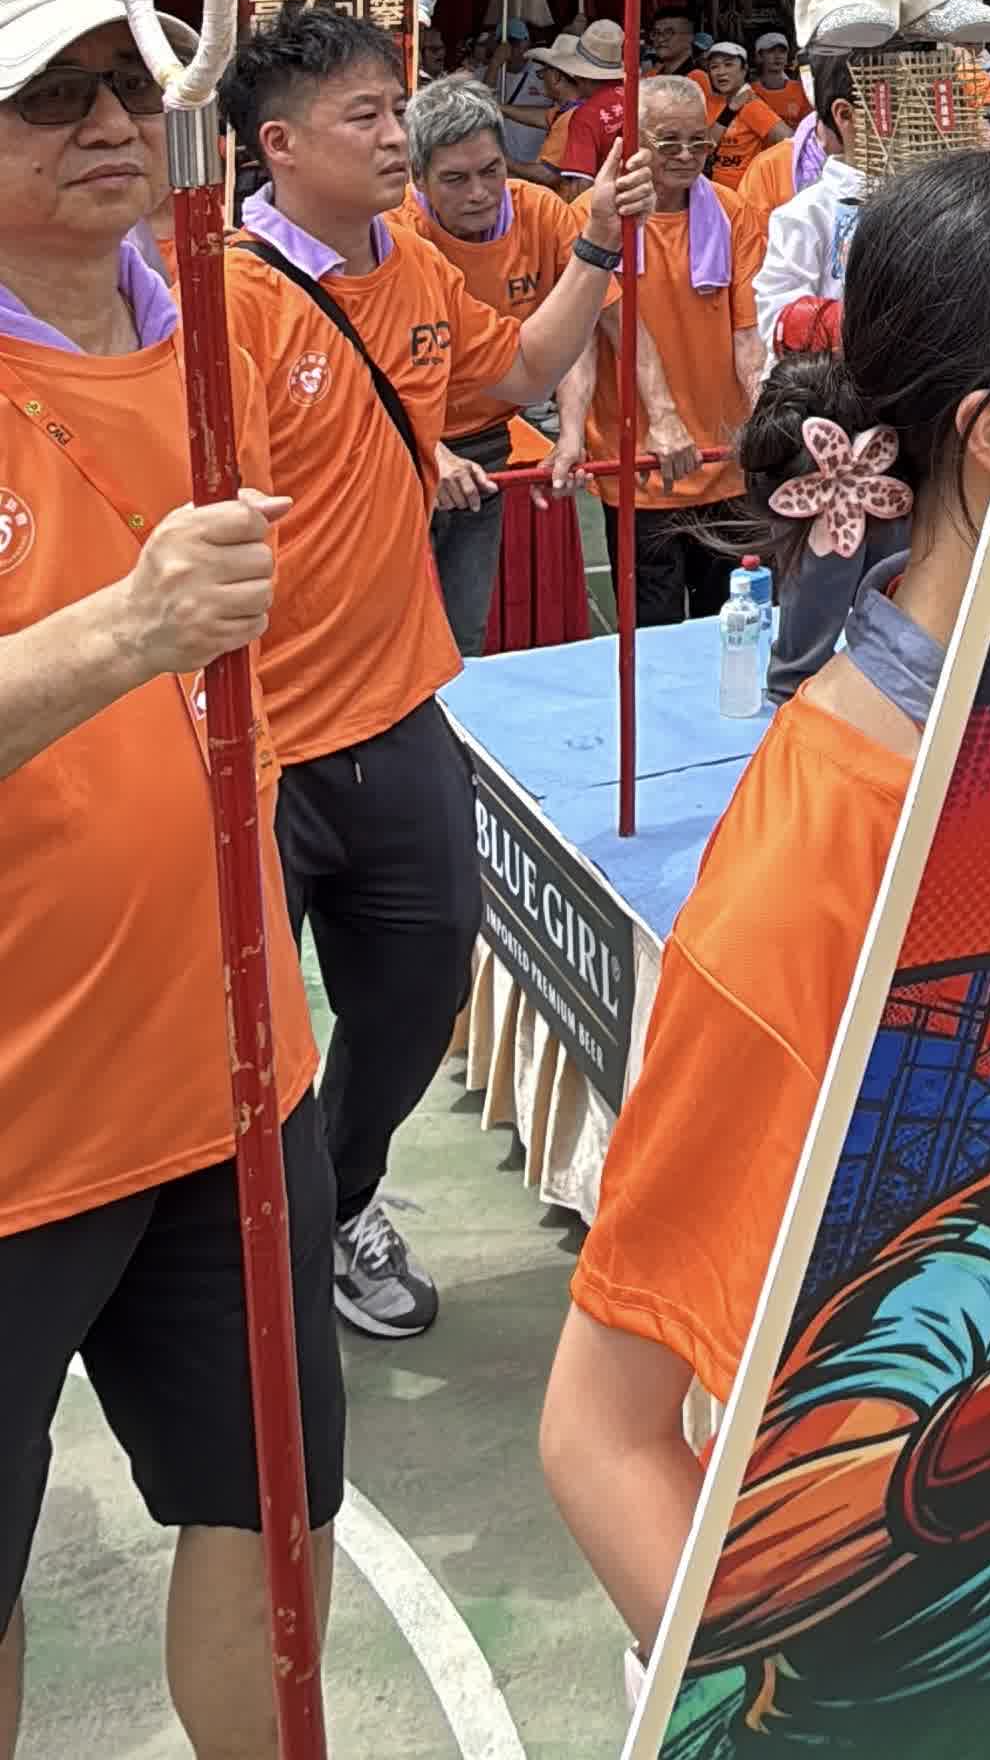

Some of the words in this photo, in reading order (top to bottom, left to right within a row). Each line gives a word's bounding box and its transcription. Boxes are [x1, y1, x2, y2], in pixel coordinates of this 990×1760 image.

[475, 798, 539, 922] BLUE
[486, 903, 529, 973] IMPORTED
[530, 963, 576, 1038] PREMIUM
[578, 1029, 605, 1072] BEER
